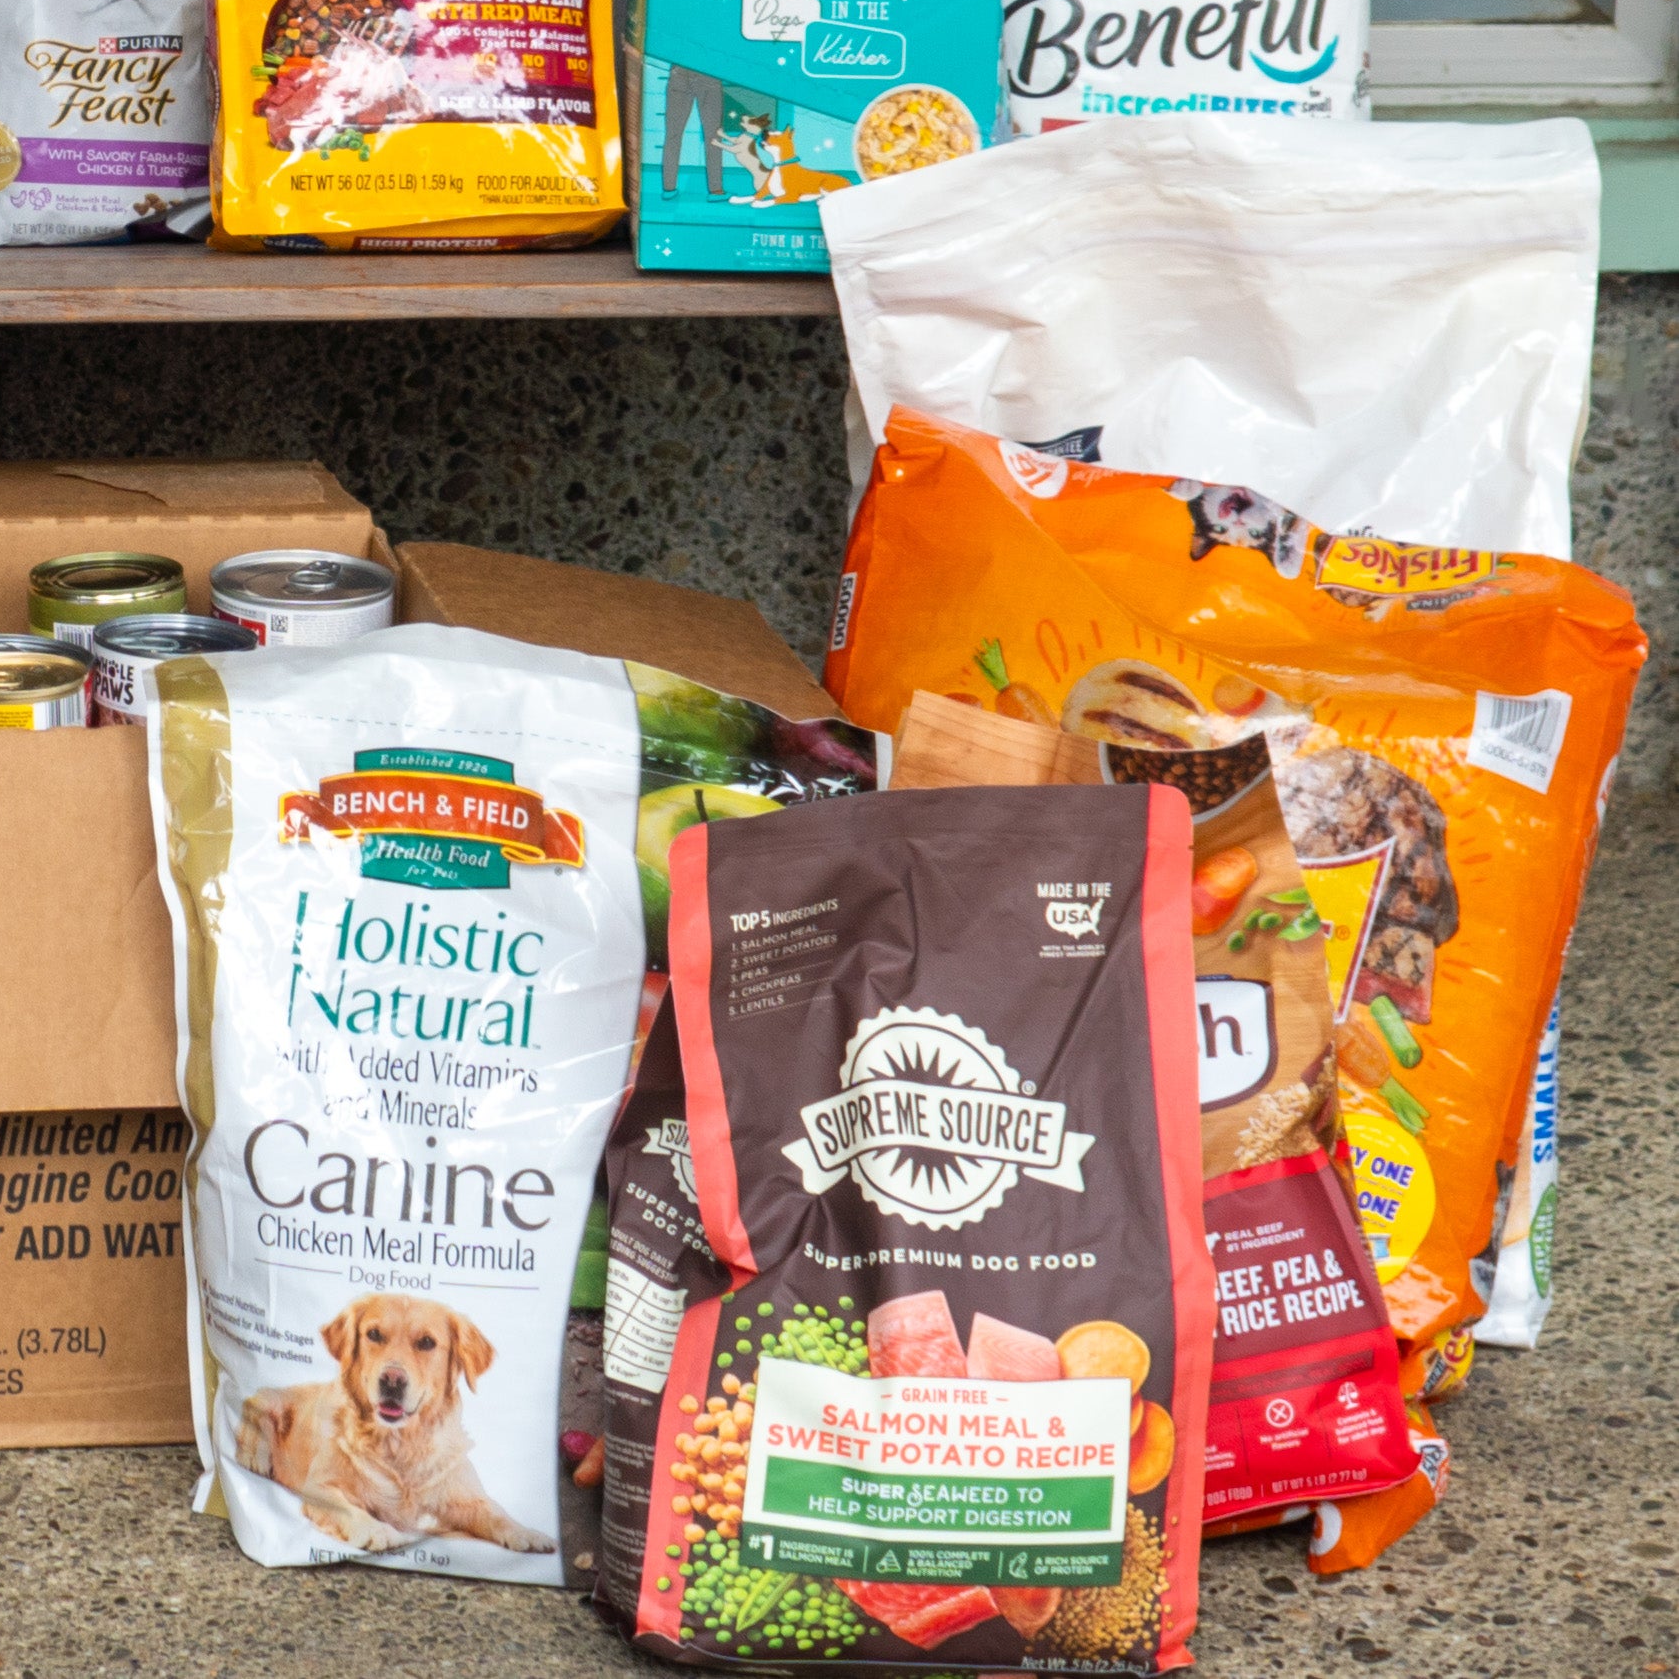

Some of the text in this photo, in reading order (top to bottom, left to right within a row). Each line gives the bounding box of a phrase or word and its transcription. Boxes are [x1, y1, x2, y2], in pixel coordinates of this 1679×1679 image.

[831, 0, 848, 20] IN
[854, 1, 889, 21] THE
[119, 37, 180, 50] PURINA
[813, 35, 892, 66] Kitchen
[25, 39, 182, 94] Fancy
[48, 83, 176, 128] Feast
[291, 174, 463, 193] NET WT 56 OZ (3.5 LB) 1.59 kg
[94, 678, 134, 705] PAWS
[333, 791, 529, 830] BENCH & FIELD
[730, 898, 839, 933] TOP 5 INGREDIENTS
[1052, 908, 1092, 924] USA
[292, 891, 543, 977] Holistic
[288, 963, 534, 1049] Natural
[133, 1113, 185, 1155] An
[815, 1100, 1052, 1156] SUPREME SOURCE
[243, 1119, 555, 1231] Canine
[15, 1224, 91, 1261] ADD
[104, 1223, 185, 1258] WAT
[257, 1213, 535, 1272] Chicken Meal Formula
[971, 1253, 1019, 1271] DOG
[1030, 1252, 1097, 1270] FOOD
[1273, 1255, 1322, 1290] PEA
[1324, 1249, 1344, 1279] &
[1221, 1279, 1365, 1338] RICE RECIPE
[16, 1326, 108, 1360] (3.78L)
[901, 1388, 988, 1404] GRAIN FREE
[821, 1404, 1066, 1438] SALMON MEAL &
[767, 1423, 1115, 1468] SWEET POTATO RECIPE
[841, 1477, 1043, 1506] SUPER SEAWEED TO
[808, 1496, 1071, 1526] HELP SUPPORT DIGESTION
